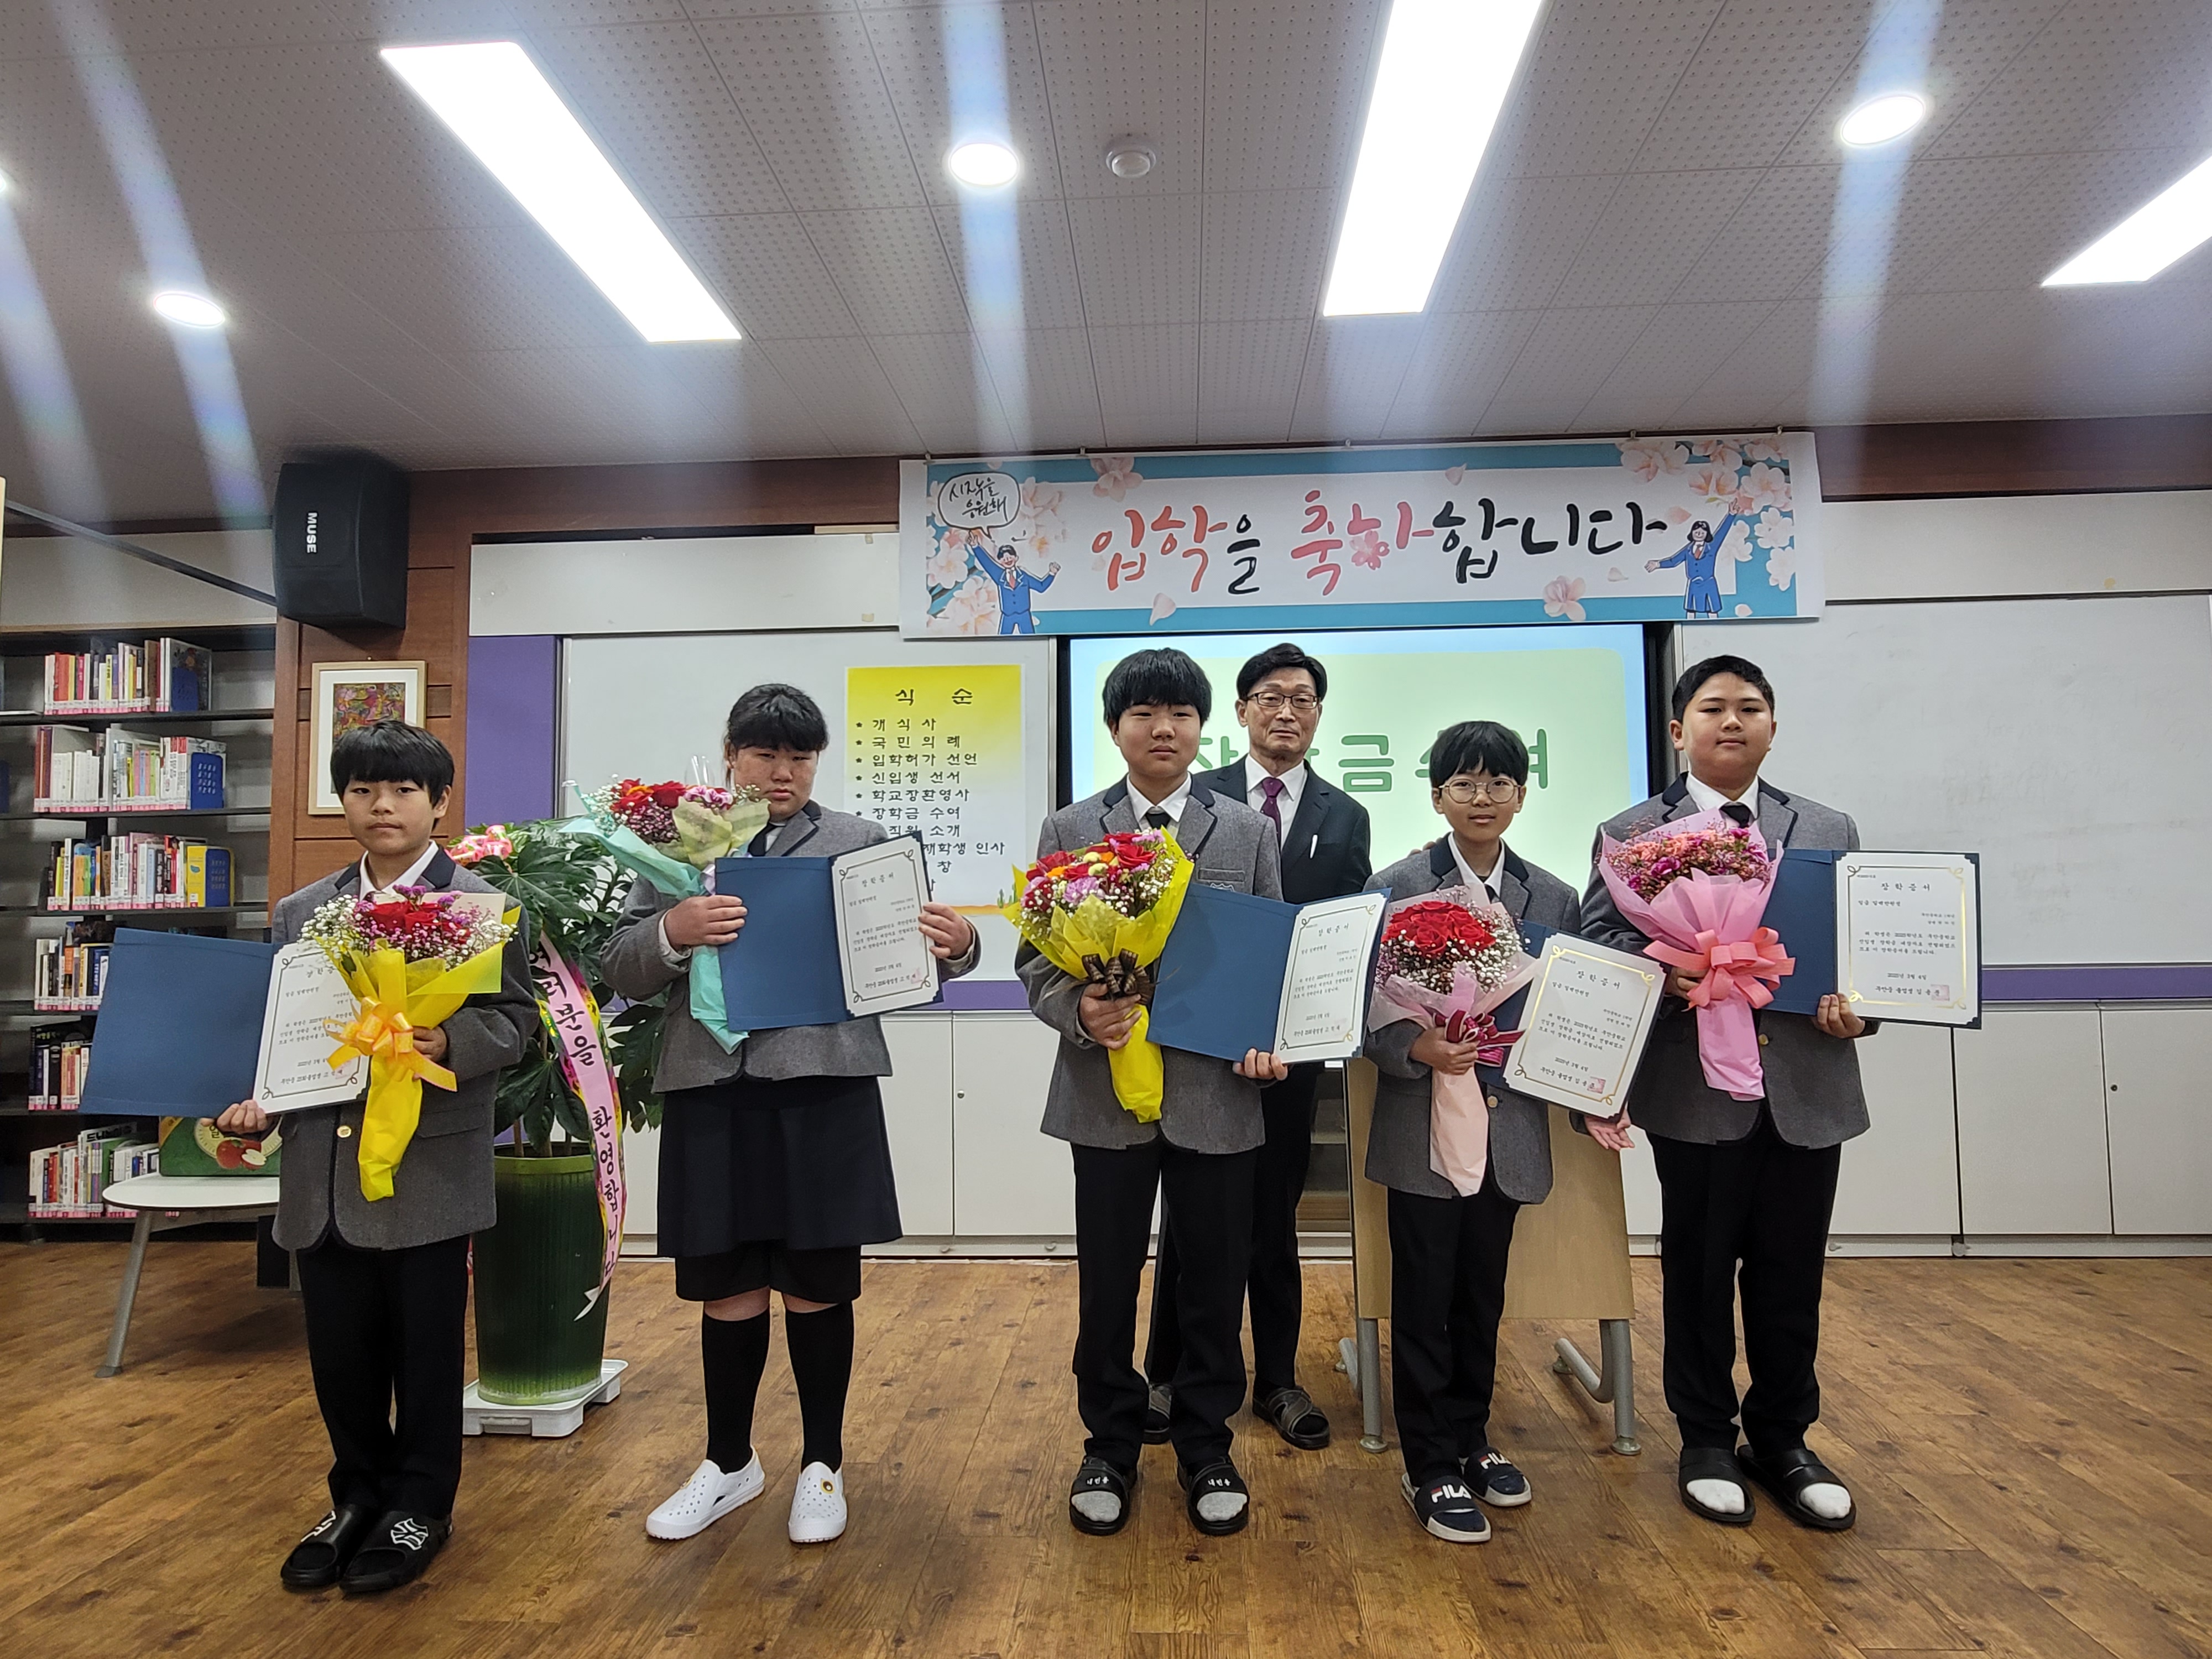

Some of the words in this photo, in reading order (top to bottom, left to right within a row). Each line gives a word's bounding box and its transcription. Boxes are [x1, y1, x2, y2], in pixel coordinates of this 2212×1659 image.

[949, 477, 1000, 502] 시작을
[962, 496, 1008, 523] 응원해
[306, 512, 317, 554] MUSE
[1092, 505, 1261, 594] 입학을
[1290, 489, 1668, 596] 축하합니다
[895, 688, 915, 706] 식
[952, 688, 973, 705] 순
[872, 754, 937, 767] 입학허가
[947, 753, 978, 766] 선언
[872, 772, 919, 785] 신입생
[930, 771, 961, 784] 선서
[872, 790, 971, 802] 학교장환영사
[873, 807, 920, 820] 장학금
[930, 807, 961, 820] 수여
[930, 825, 961, 838] 소개
[976, 842, 1005, 855] 인사
[937, 860, 952, 873] 창
[592, 1105, 619, 1277] 환영합니다
[1479, 1452, 1512, 1470] FILA
[1431, 1484, 1472, 1504] FILA
